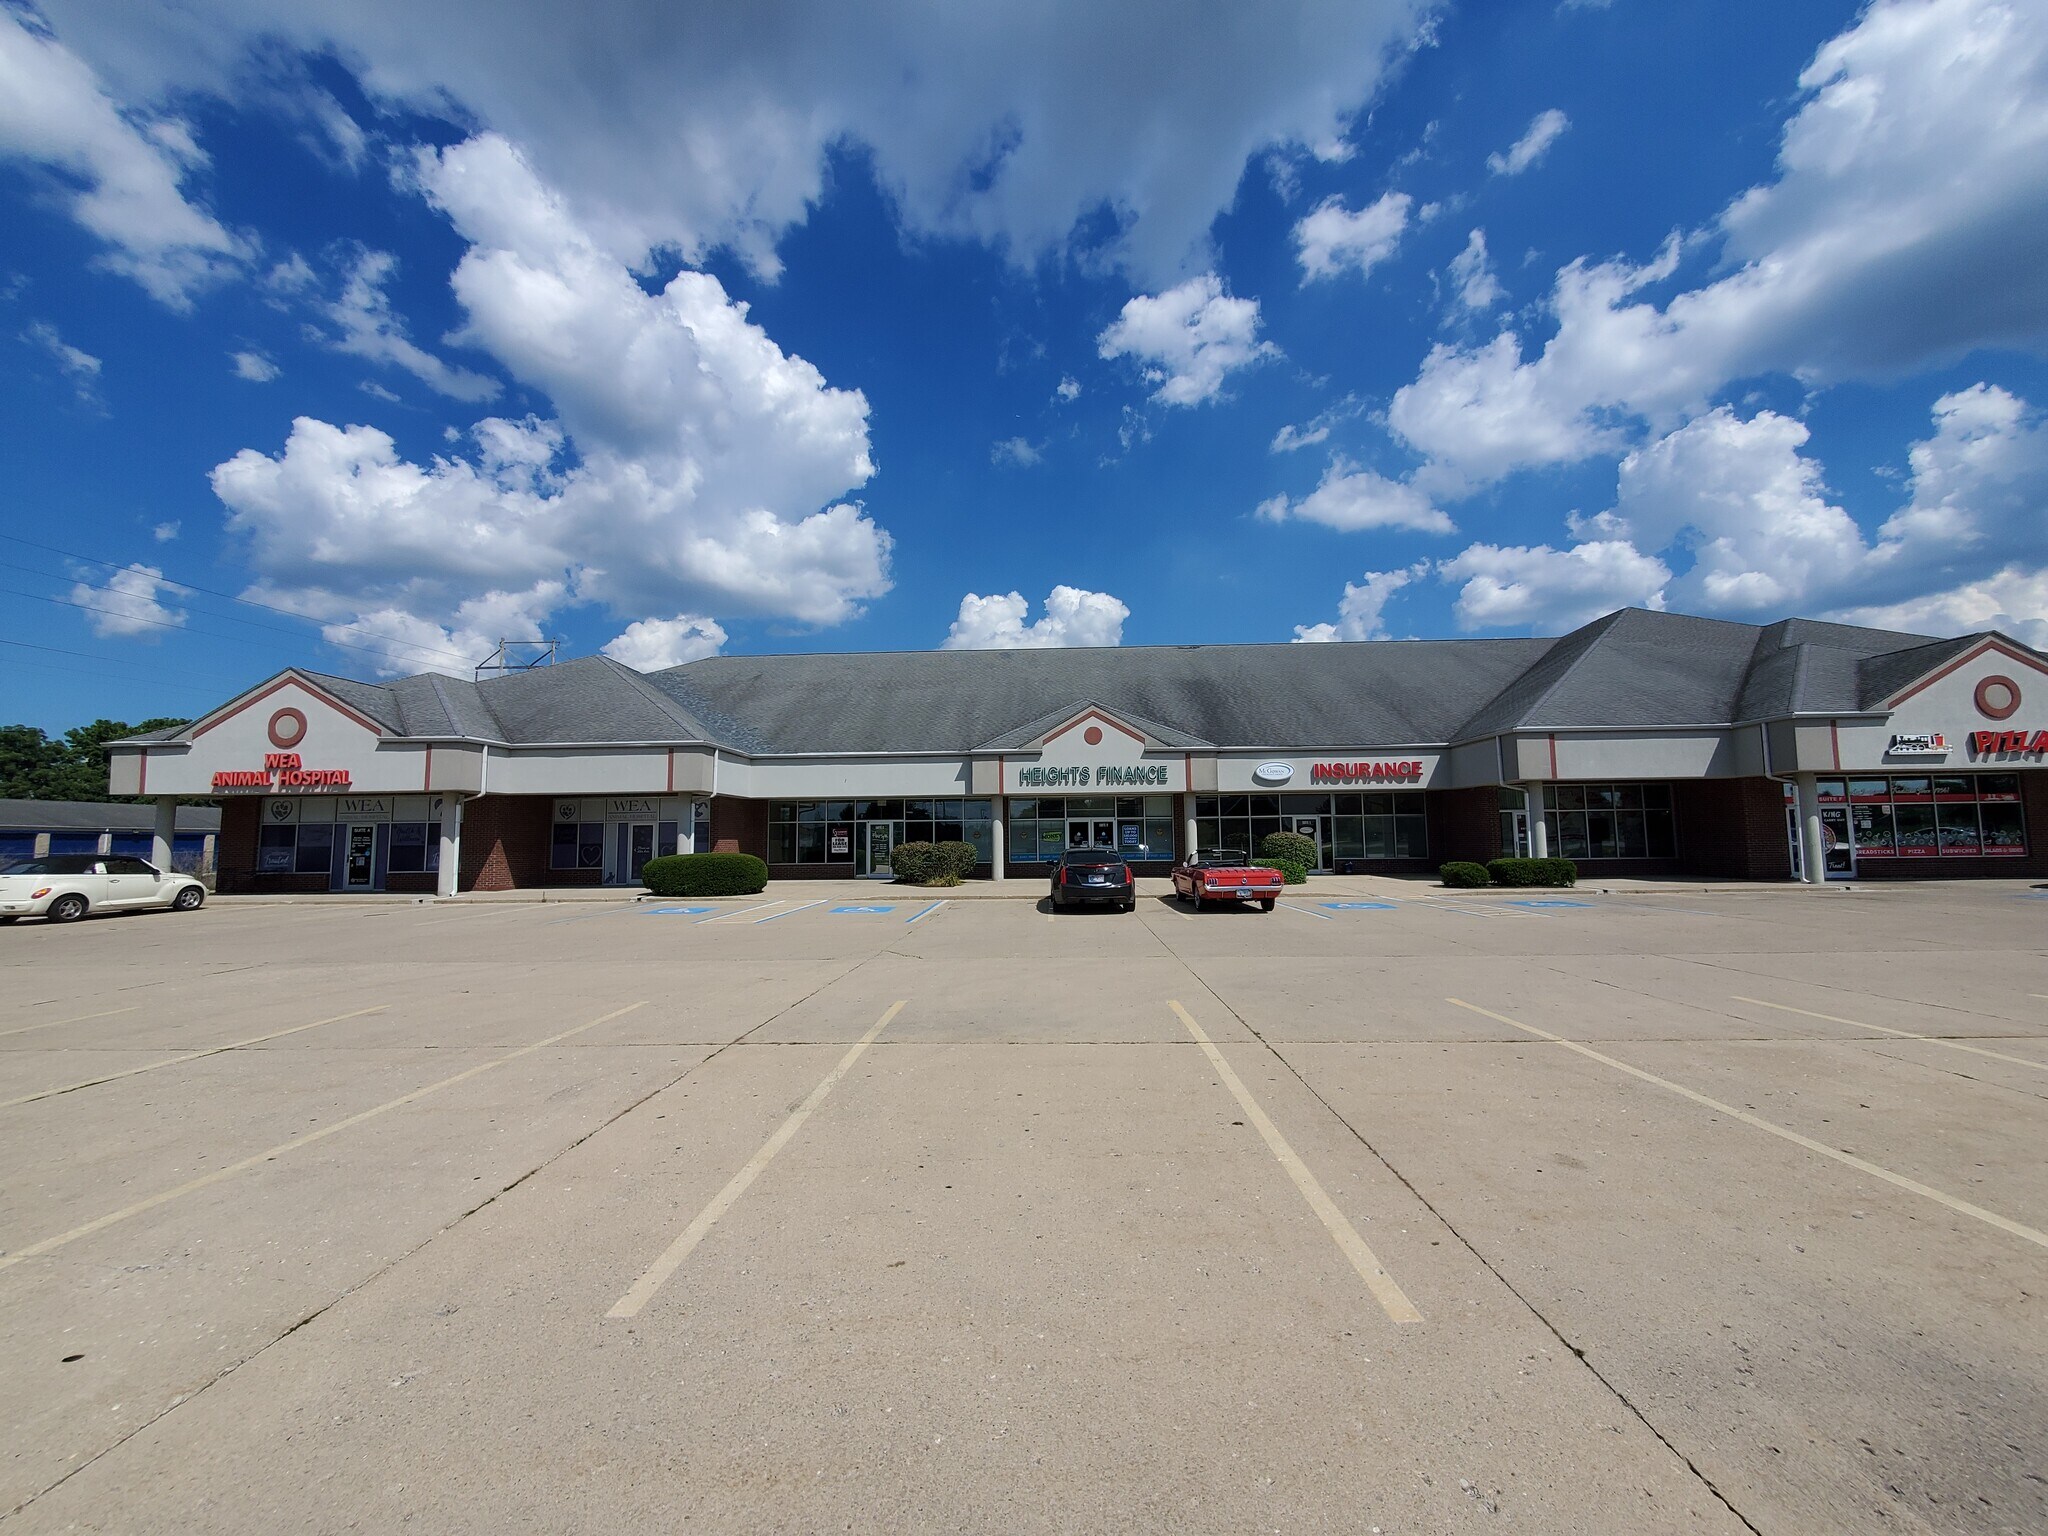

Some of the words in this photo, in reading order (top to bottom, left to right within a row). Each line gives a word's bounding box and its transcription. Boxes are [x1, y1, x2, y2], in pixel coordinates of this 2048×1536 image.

[1974, 729, 2048, 753] PIZZA
[265, 753, 302, 769] WEA
[211, 771, 274, 787] ANIMAL
[278, 770, 352, 786] HOSPITAL
[1020, 766, 1091, 783] HEIGHTS
[1097, 765, 1169, 782] FINANCE
[1313, 761, 1423, 779] INSURANCE
[345, 799, 385, 811] WEA
[613, 800, 652, 811] WEA
